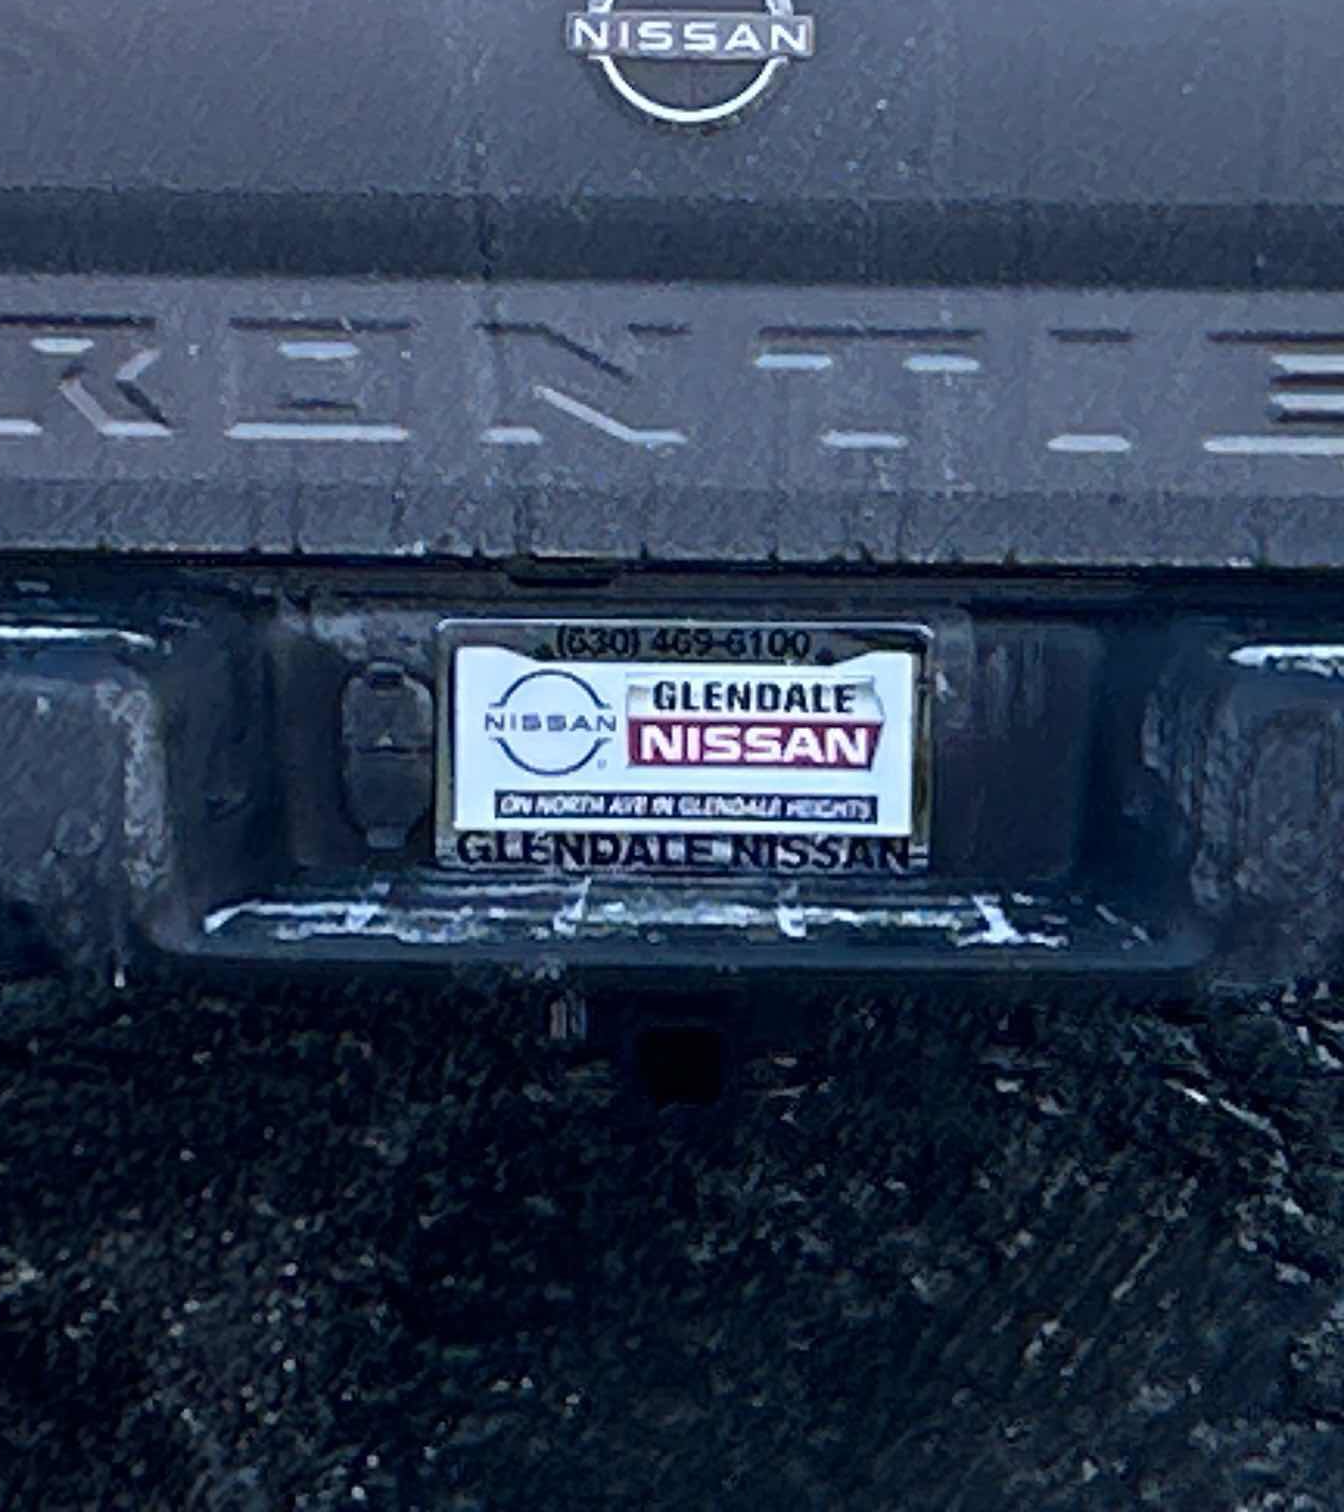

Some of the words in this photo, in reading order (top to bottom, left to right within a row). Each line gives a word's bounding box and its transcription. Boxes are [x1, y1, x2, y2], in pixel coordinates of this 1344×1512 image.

[573, 19, 806, 52] NISSAN
[653, 680, 856, 713] GLENDALE
[484, 714, 617, 732] NISSAN
[641, 724, 868, 764] NISSAN
[535, 795, 604, 816] NORTH
[456, 833, 717, 866] GLENDALE
[729, 836, 912, 870] NISSAN
